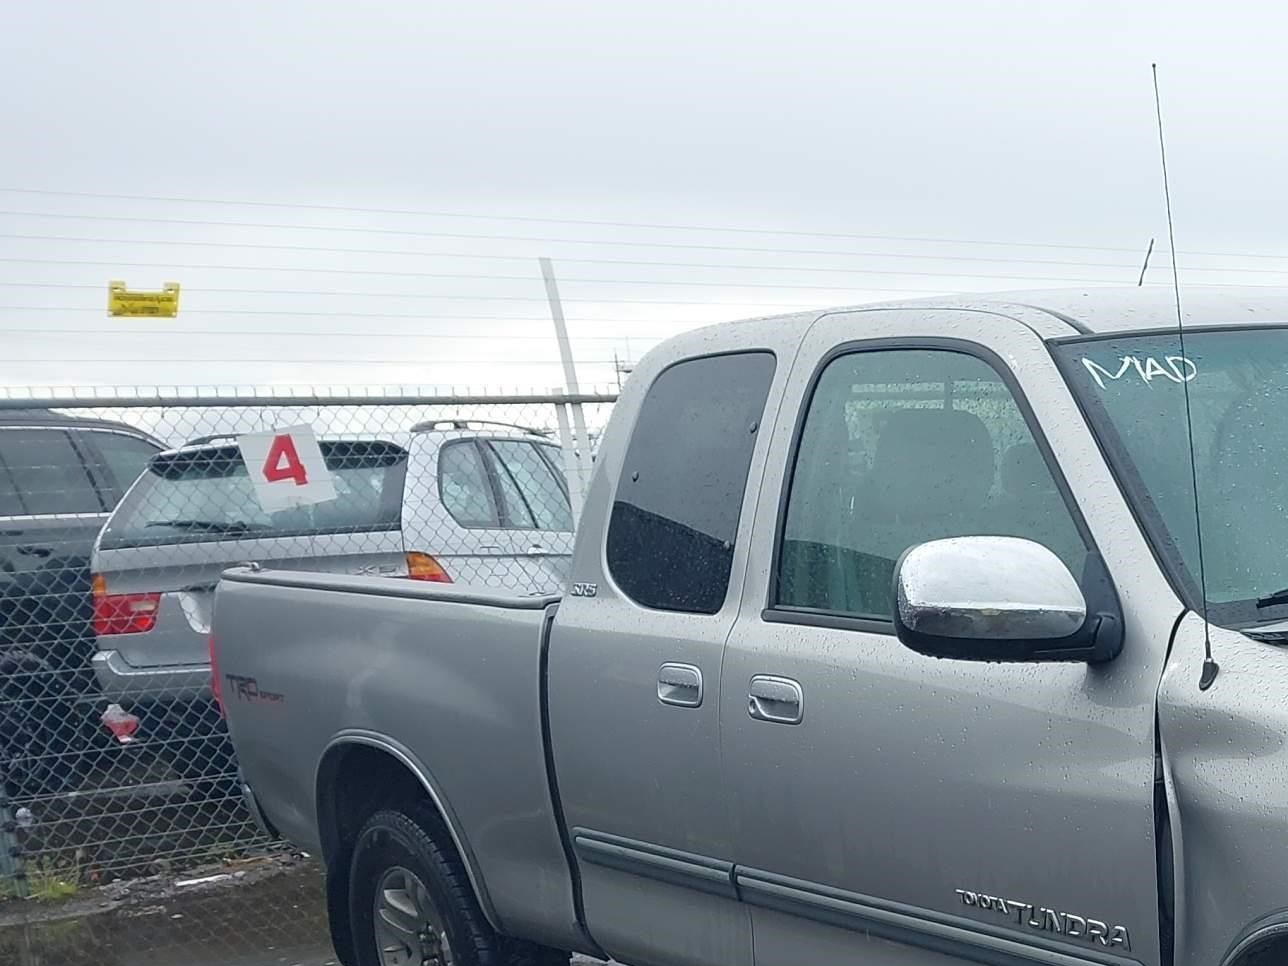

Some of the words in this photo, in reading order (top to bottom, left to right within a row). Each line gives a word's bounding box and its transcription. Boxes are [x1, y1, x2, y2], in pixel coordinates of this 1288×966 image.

[262, 433, 308, 486] 4
[225, 673, 258, 702] TRD
[955, 889, 1009, 915] TOYOTA
[1007, 900, 1132, 953] TUNDRA
